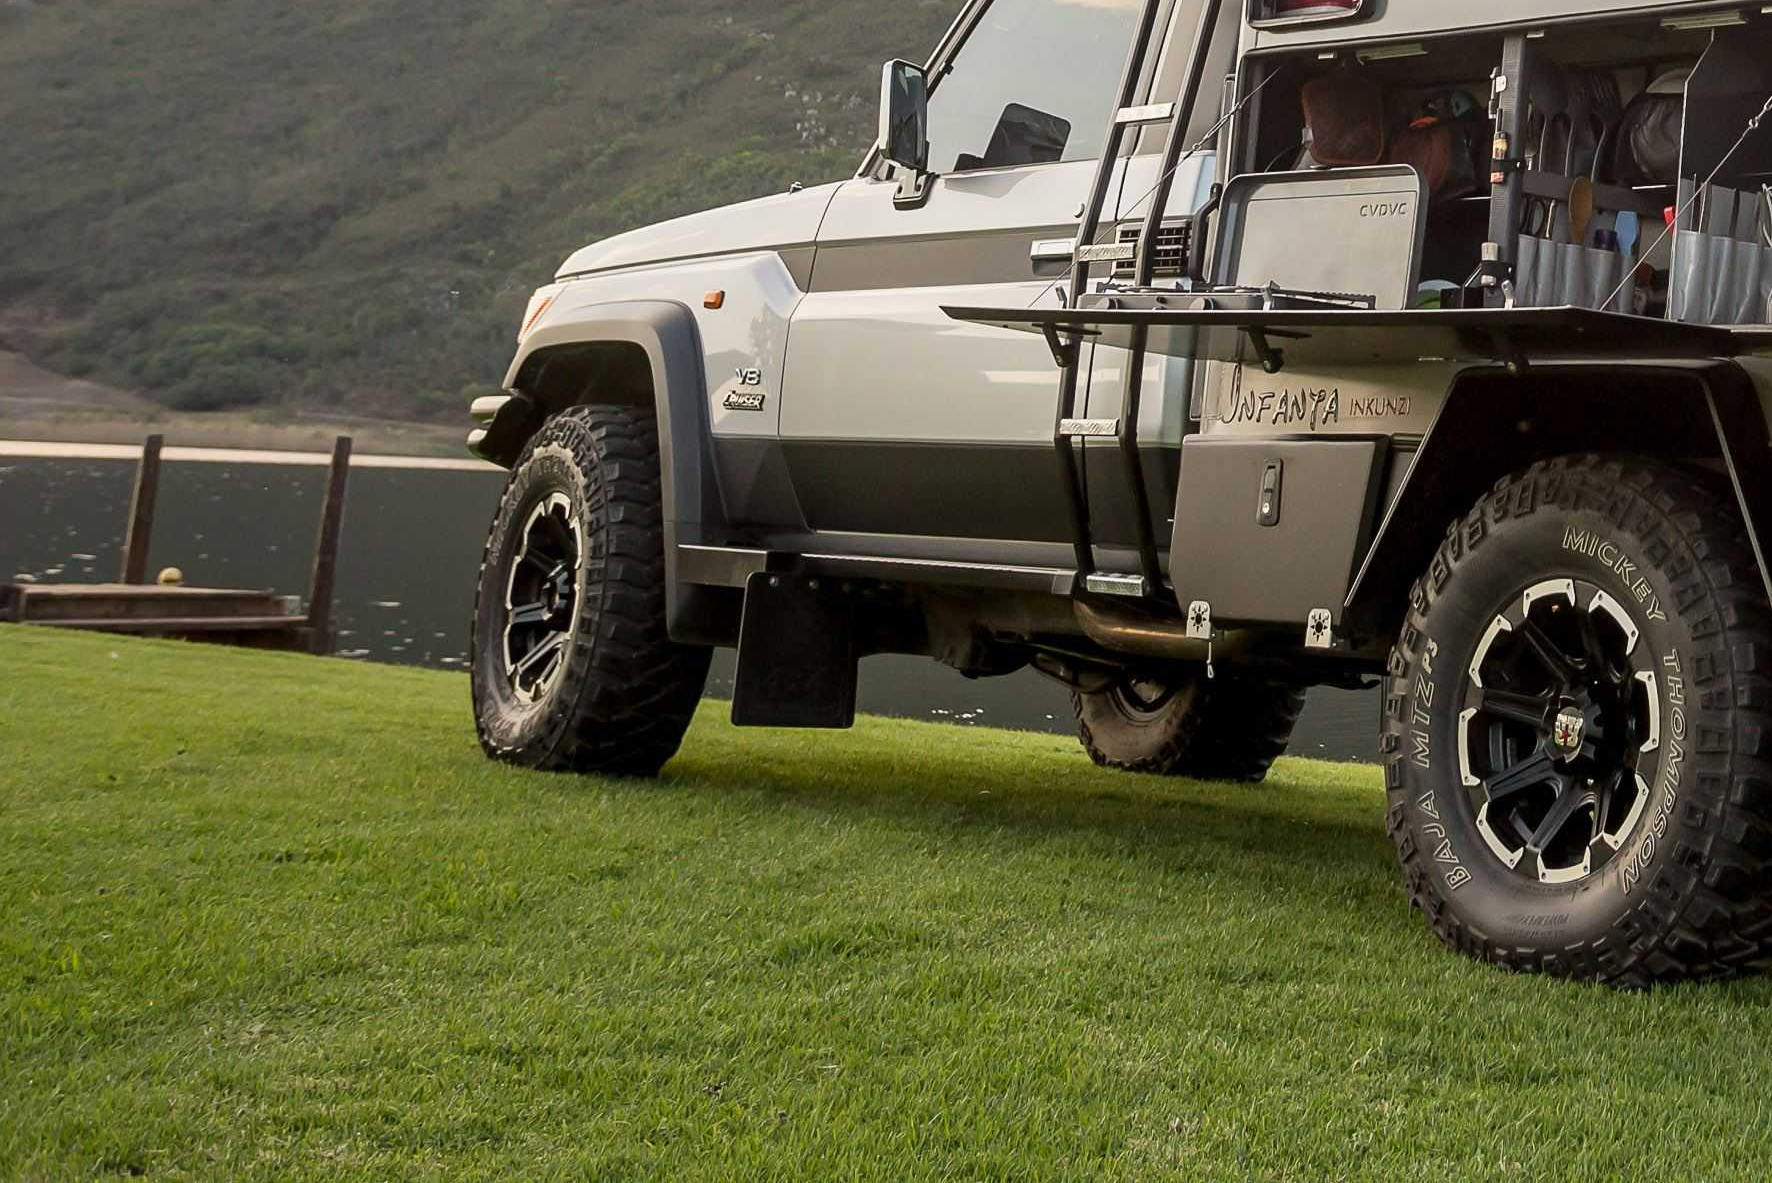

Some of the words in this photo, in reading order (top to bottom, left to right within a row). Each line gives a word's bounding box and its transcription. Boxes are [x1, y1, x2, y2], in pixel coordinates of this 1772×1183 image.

[735, 368, 761, 386] V8
[1349, 396, 1412, 417] INKUNZI
[1562, 524, 1667, 621] MICKEY
[1622, 648, 1687, 895] THOMPSON
[1416, 789, 1472, 890] BAJA
